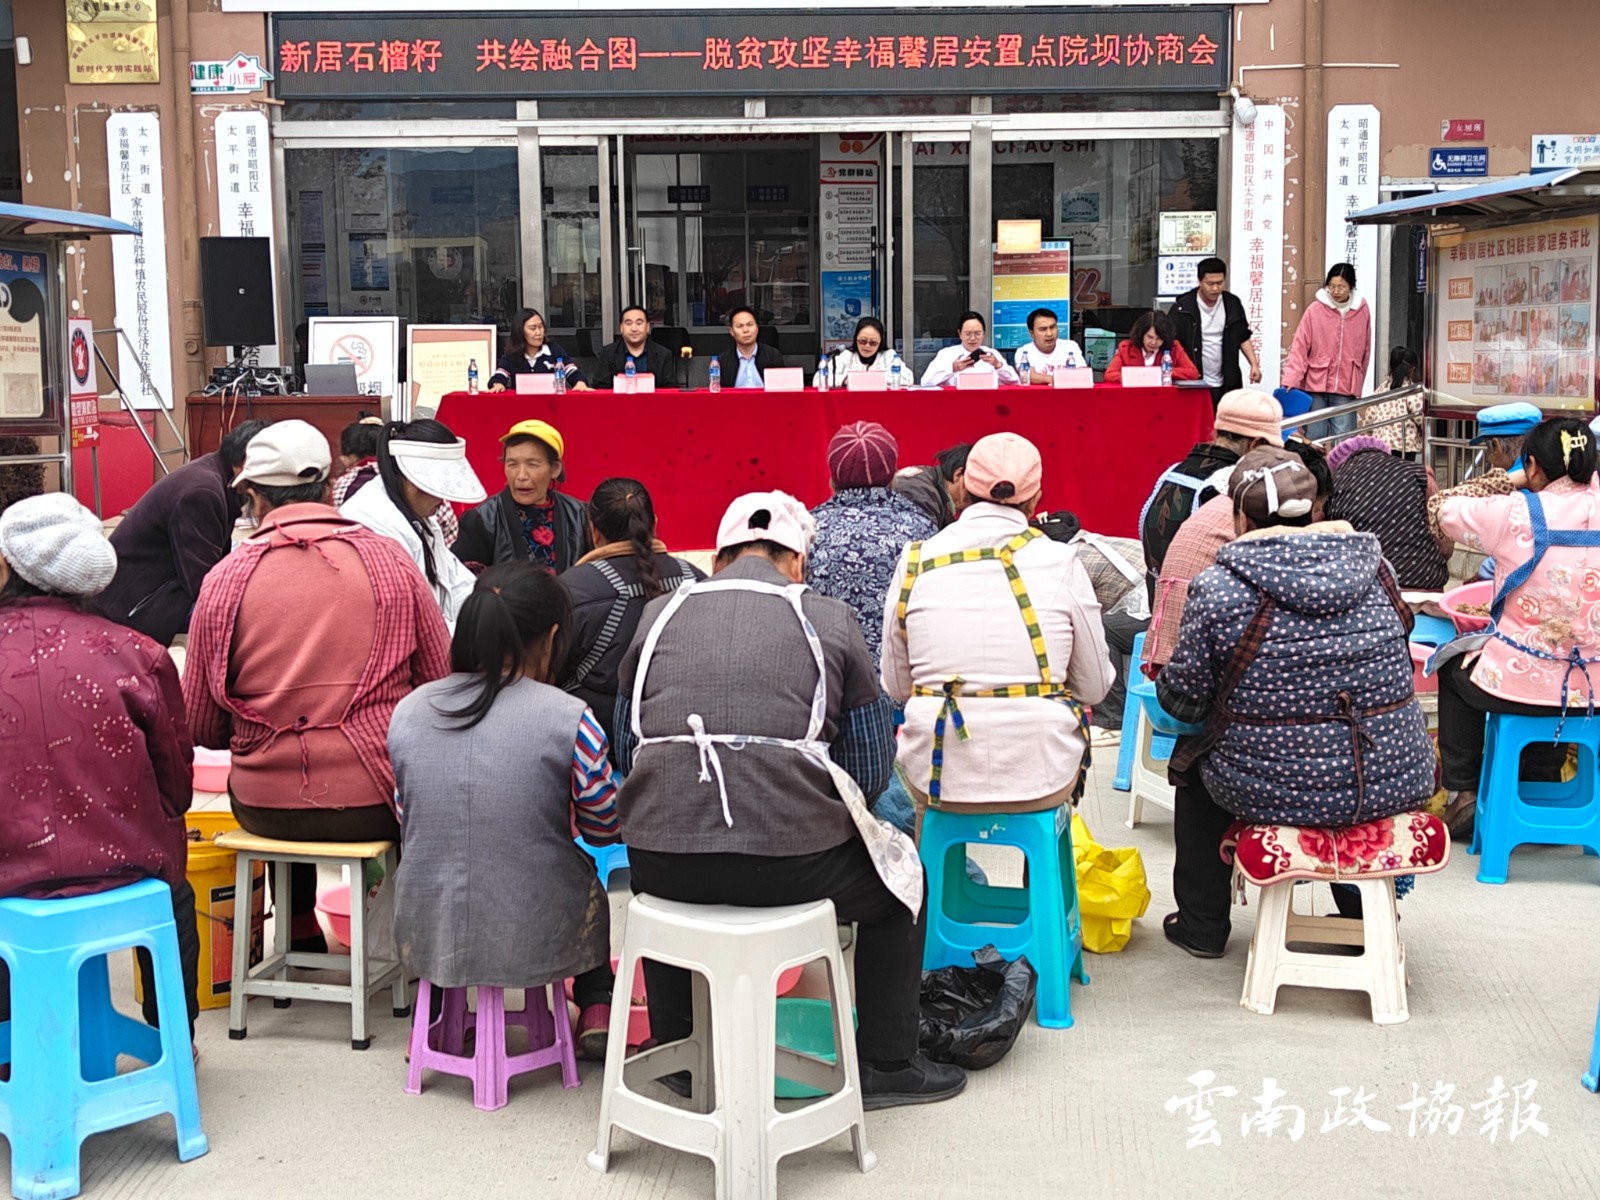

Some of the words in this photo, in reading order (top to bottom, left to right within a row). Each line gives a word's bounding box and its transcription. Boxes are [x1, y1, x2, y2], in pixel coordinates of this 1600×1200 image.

[76, 64, 152, 74] 新时代文明实践站
[280, 39, 443, 73] 新居石榴籽
[476, 33, 1219, 73] 共绘融合图——脱贫攻坚幸福馨居安置点院坝协商会
[118, 126, 131, 195] 幸福馨居社区
[138, 126, 151, 194] 太平街道
[227, 125, 240, 193] 太平街道
[246, 125, 260, 192] 昭通市昭阳区
[838, 168, 874, 177] 党群驿站
[1262, 119, 1275, 230] 中国共产党
[1339, 118, 1350, 186] 太平街道
[1357, 118, 1369, 185] 昭通市昭阳区
